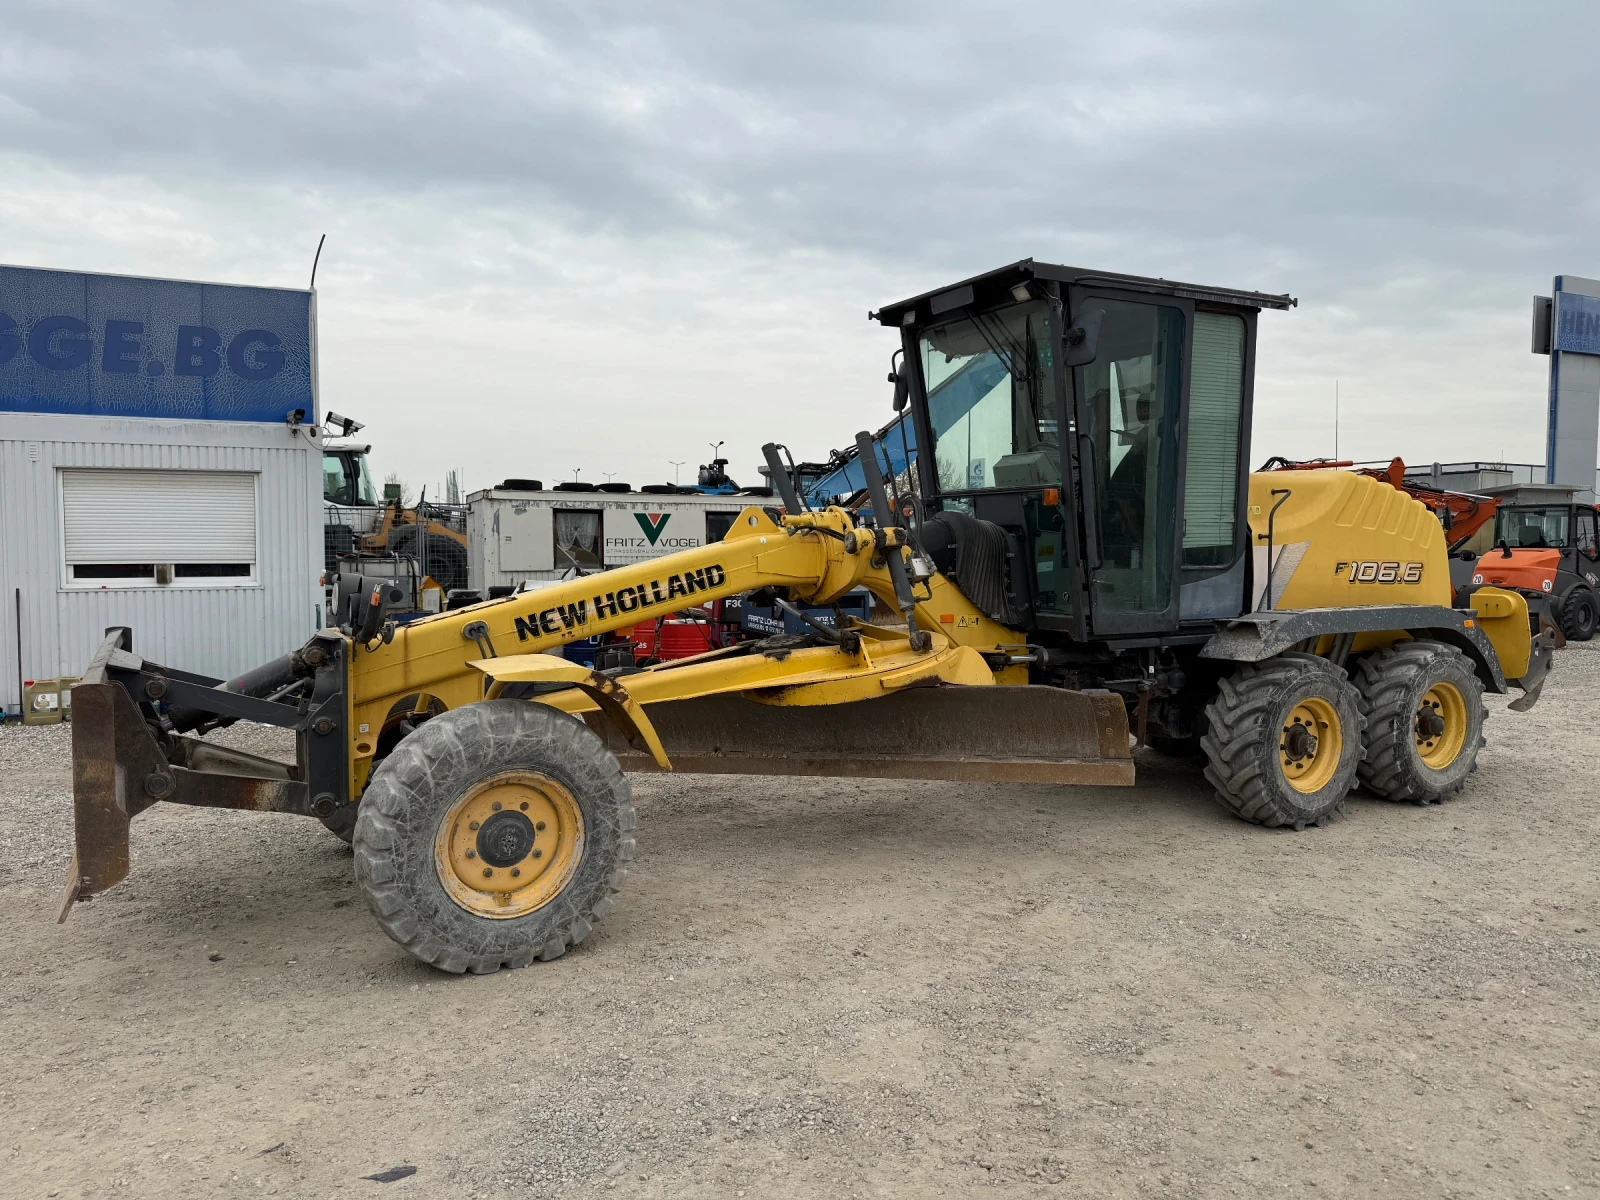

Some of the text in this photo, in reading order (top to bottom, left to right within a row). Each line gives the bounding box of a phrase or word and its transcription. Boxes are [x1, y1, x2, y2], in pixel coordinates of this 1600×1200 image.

[0, 310, 286, 381] GE.BG
[606, 538, 702, 548] FRITZ VOGEL
[1335, 561, 1424, 584] F106.6
[1474, 575, 1482, 584] 20
[1544, 582, 1551, 590] 20
[513, 564, 726, 642] NEW HOLLAND
